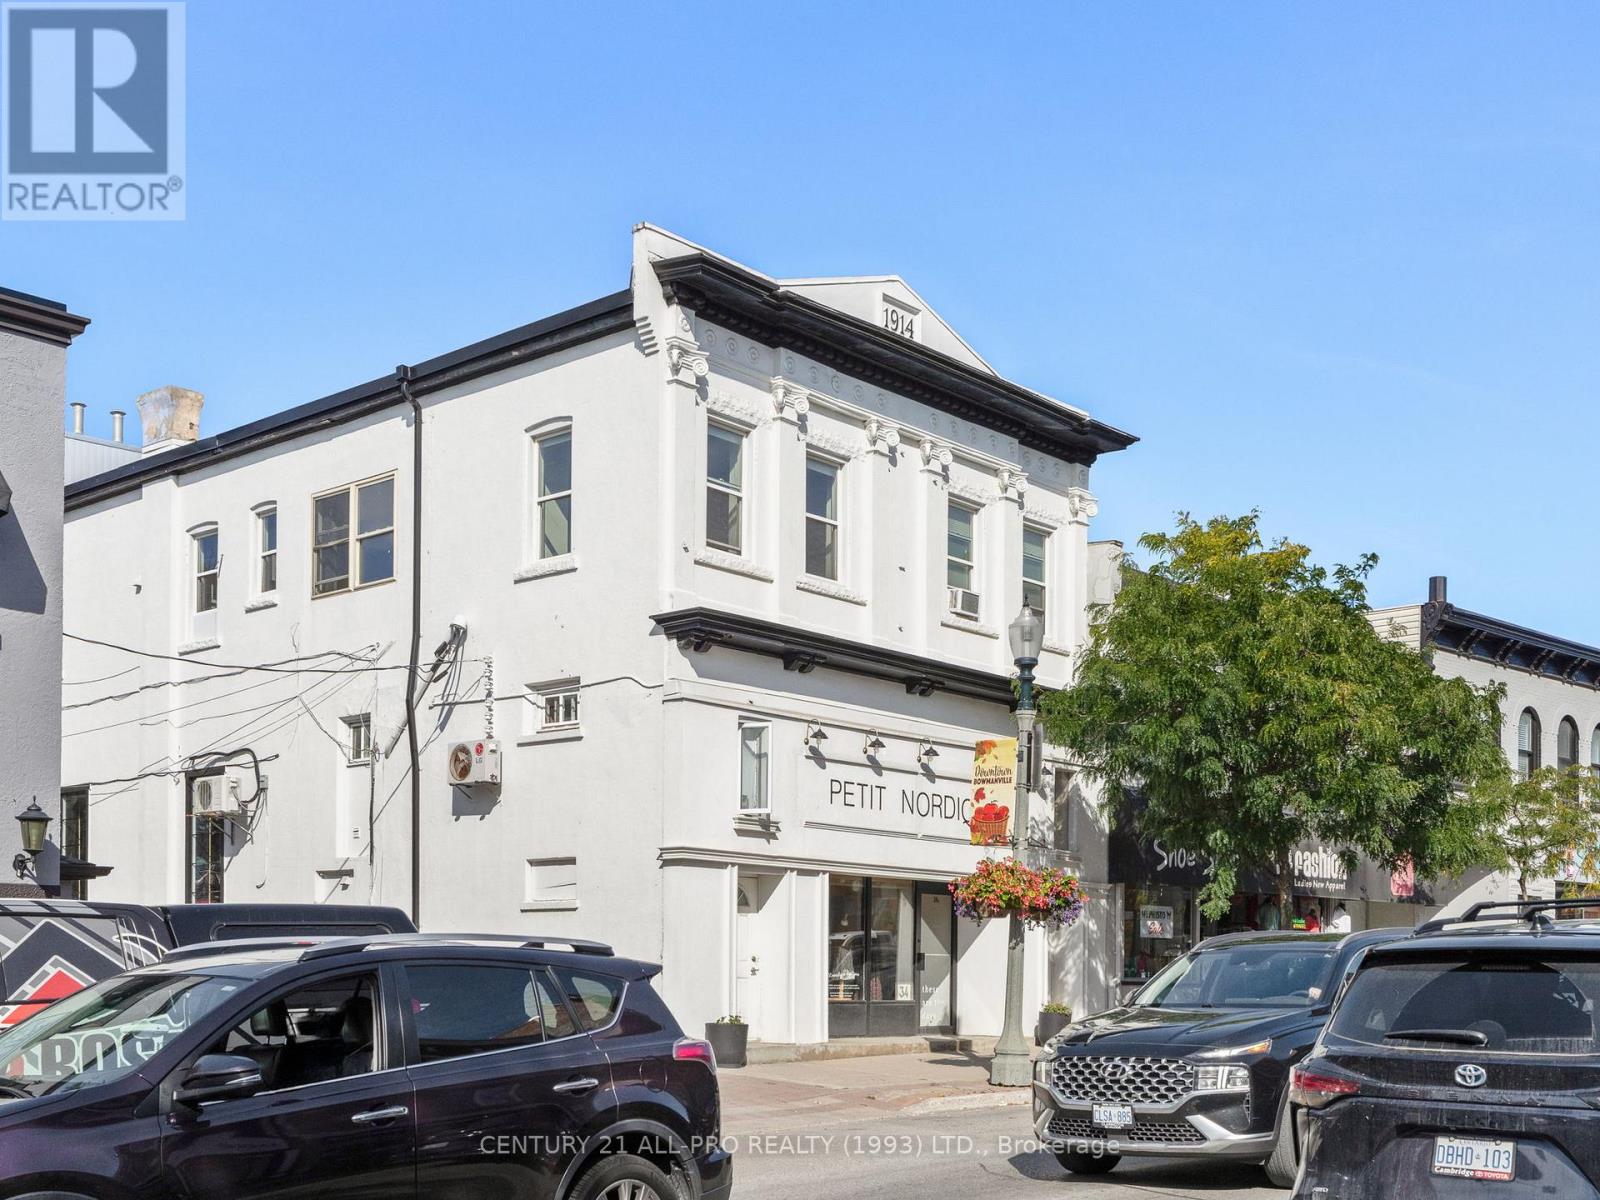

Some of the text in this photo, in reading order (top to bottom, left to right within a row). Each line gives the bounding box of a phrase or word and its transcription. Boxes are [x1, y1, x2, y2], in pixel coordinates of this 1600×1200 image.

[883, 307, 914, 339] 1914
[974, 765, 1012, 777] Downtown
[973, 777, 1013, 785] BOWMANVILLE
[829, 779, 887, 811] PETIT
[1325, 880, 1346, 893] Apparel
[899, 986, 909, 998] 34
[1436, 1144, 1512, 1170] DBHD 103
[1434, 1166, 1509, 1180] Cambridge TOYOTA
